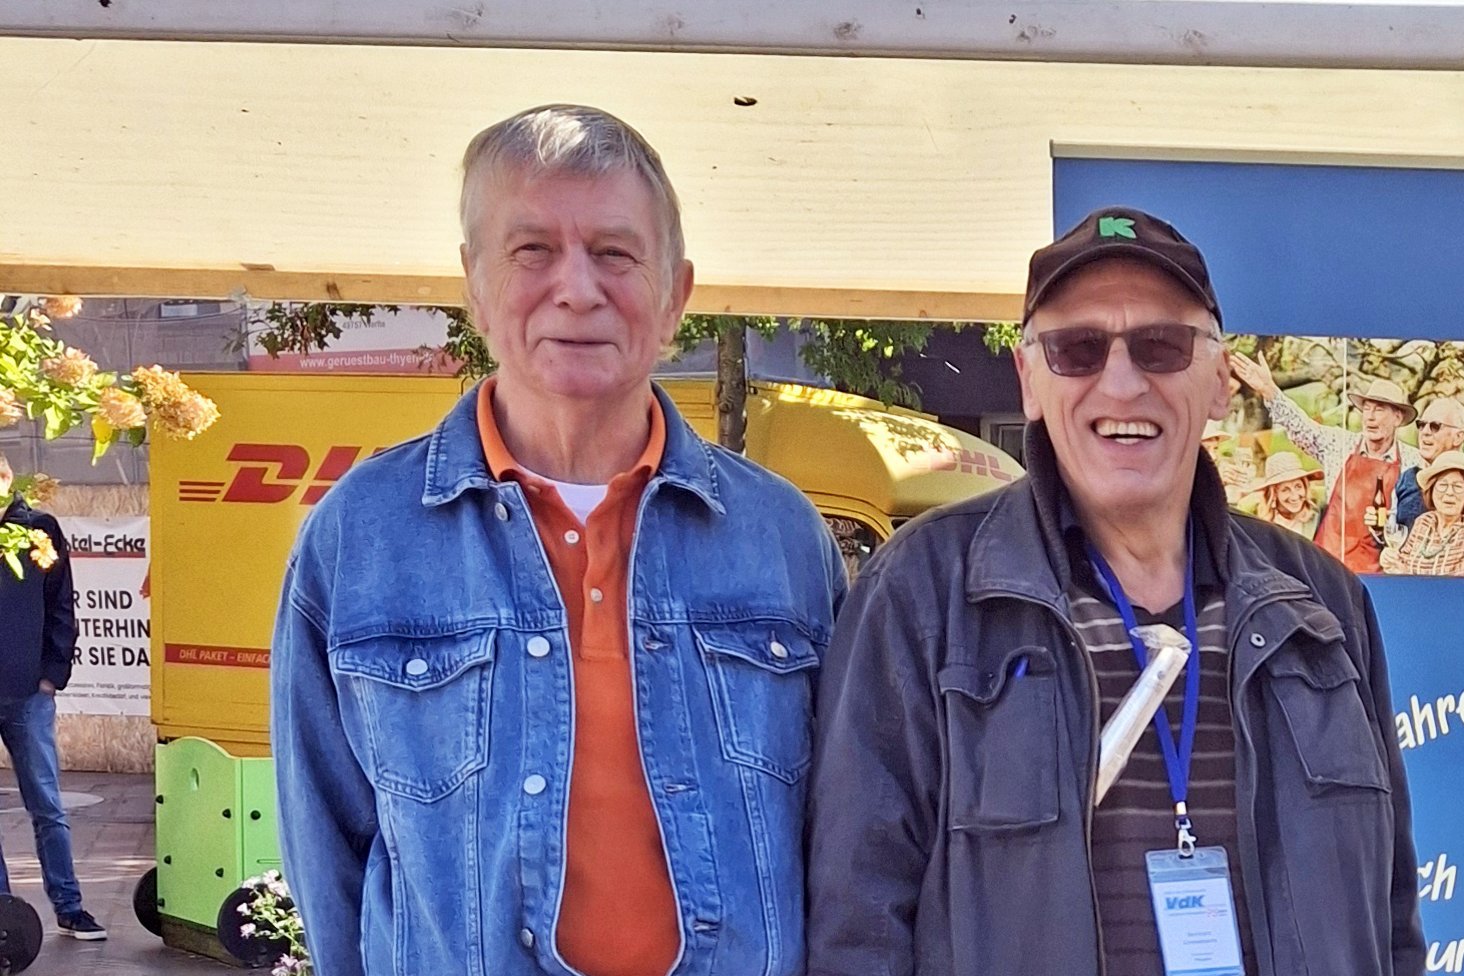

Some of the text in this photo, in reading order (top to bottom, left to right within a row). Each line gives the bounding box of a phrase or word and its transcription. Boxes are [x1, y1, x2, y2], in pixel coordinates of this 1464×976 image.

[86, 589, 133, 610] SIND
[88, 646, 117, 666] SIE
[121, 646, 151, 667] DA
[199, 650, 228, 661] PAKET
[1165, 894, 1206, 910] VdK
